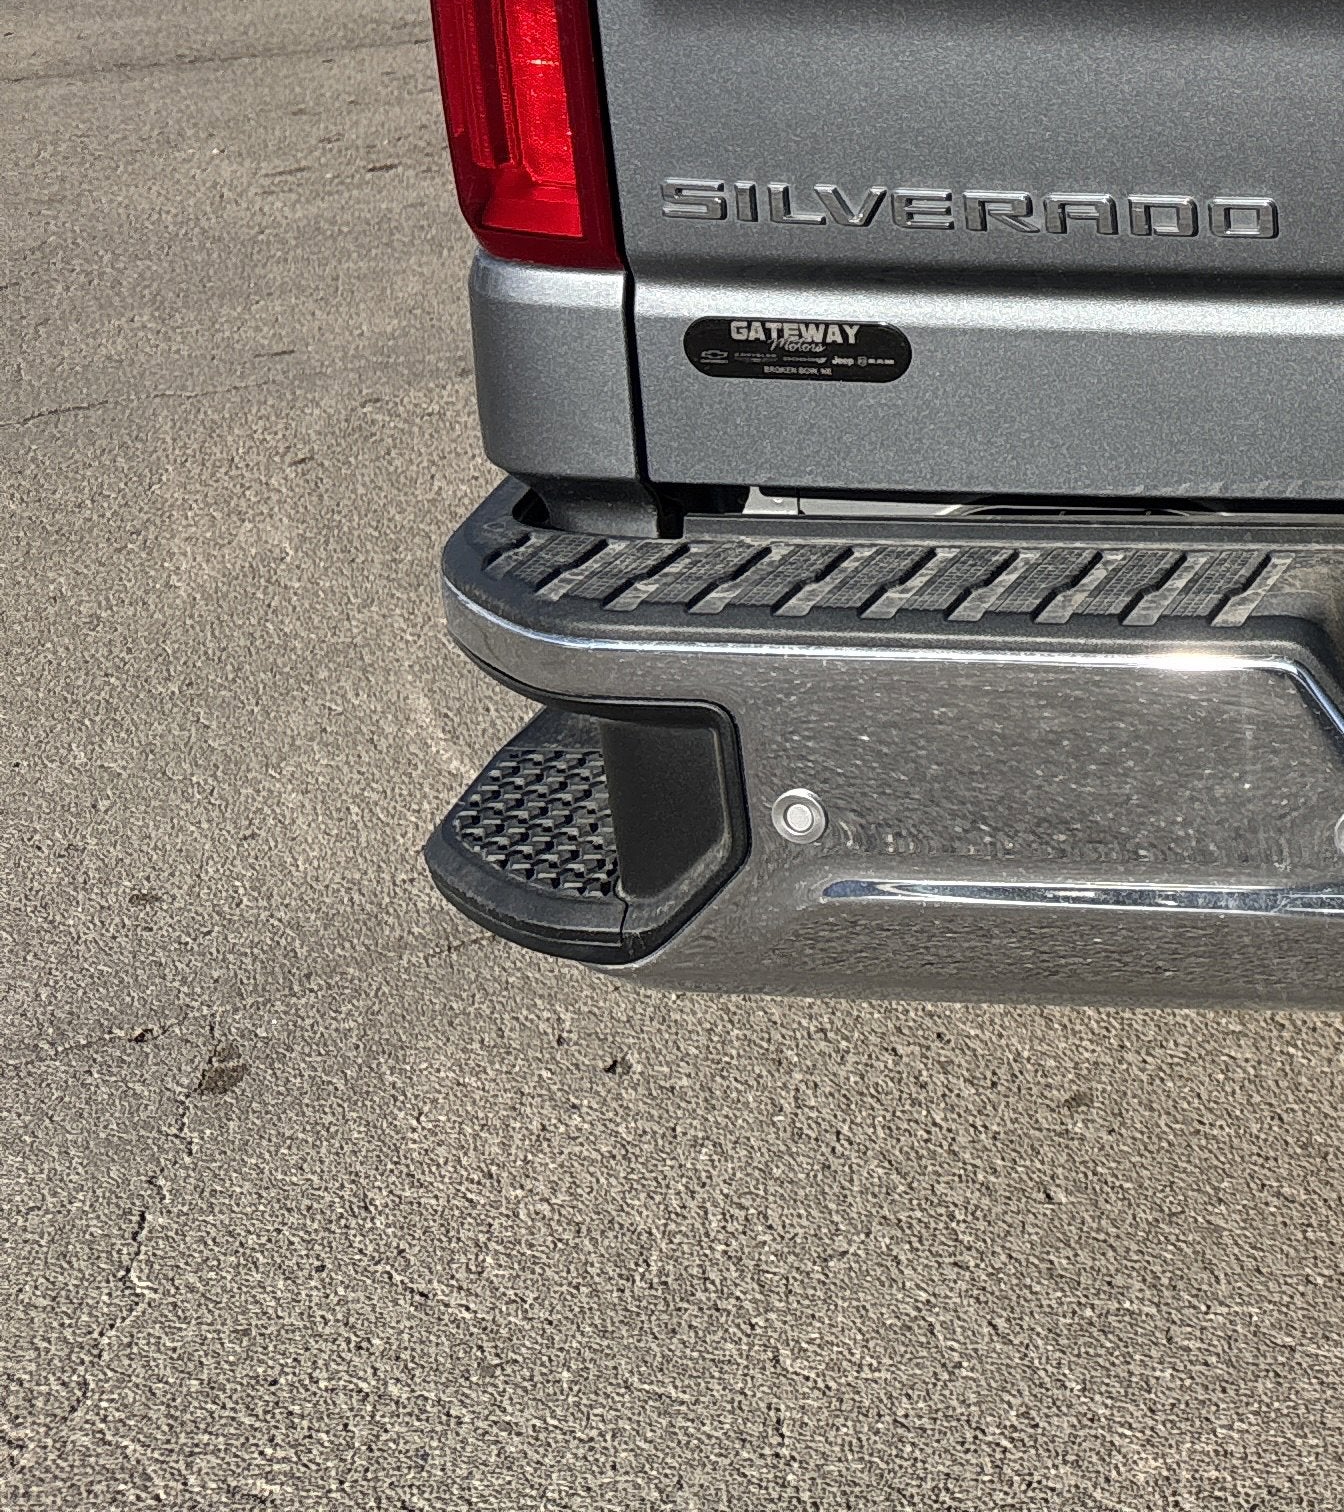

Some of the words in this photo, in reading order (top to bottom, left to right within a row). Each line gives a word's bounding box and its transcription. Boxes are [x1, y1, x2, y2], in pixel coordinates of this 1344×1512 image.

[660, 176, 1280, 240] SILVERADO
[730, 320, 861, 345] GATEWAY
[765, 338, 827, 353] Motors
